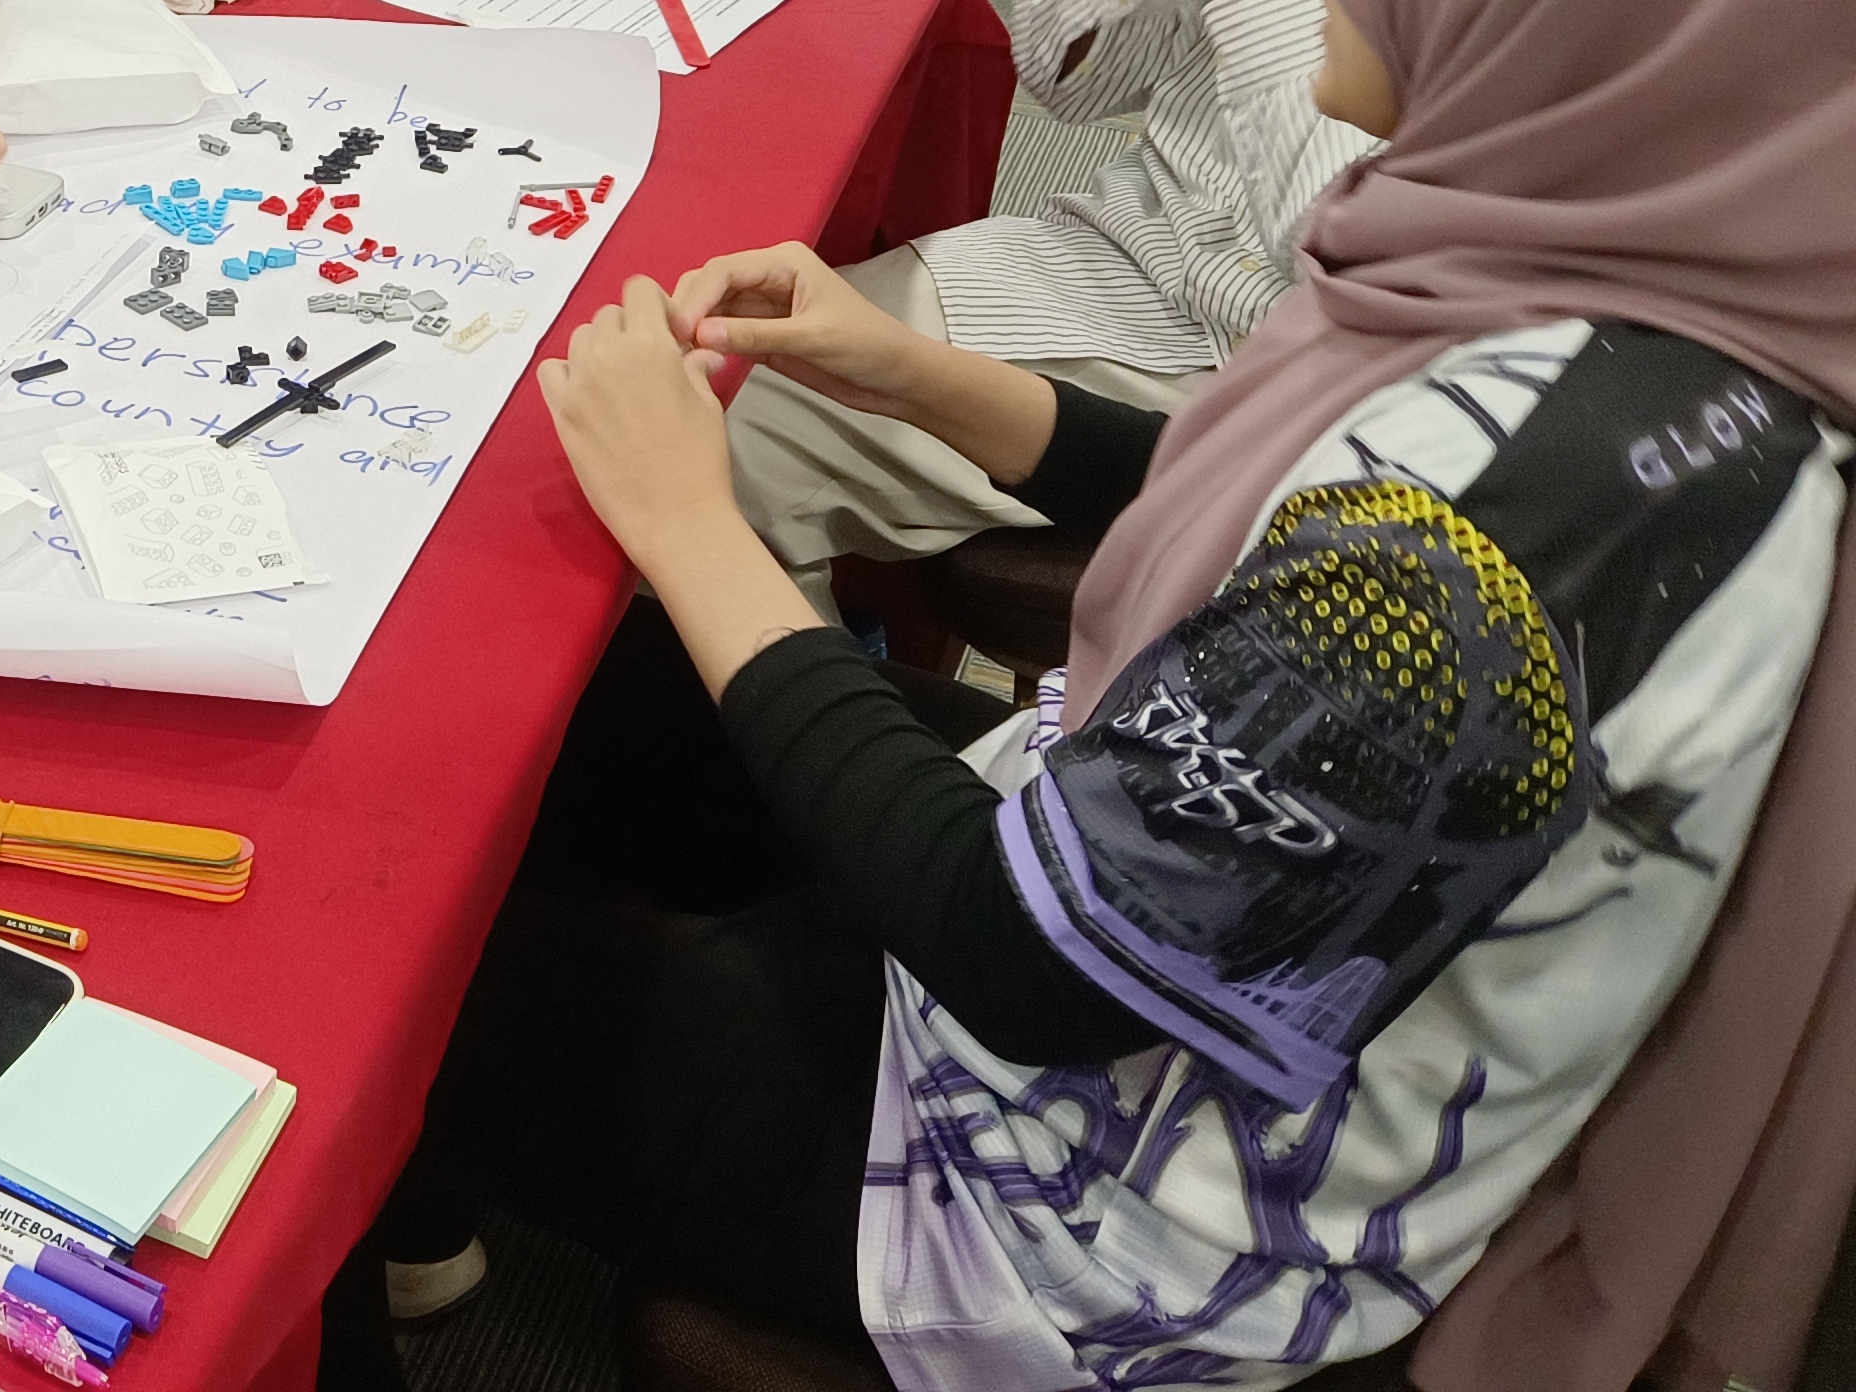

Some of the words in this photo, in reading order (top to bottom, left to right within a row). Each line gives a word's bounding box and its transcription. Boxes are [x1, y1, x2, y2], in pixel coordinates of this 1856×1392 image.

[307, 87, 347, 111] to
[387, 84, 428, 129] be
[16, 379, 305, 458] county
[1628, 378, 1775, 490] GLOW
